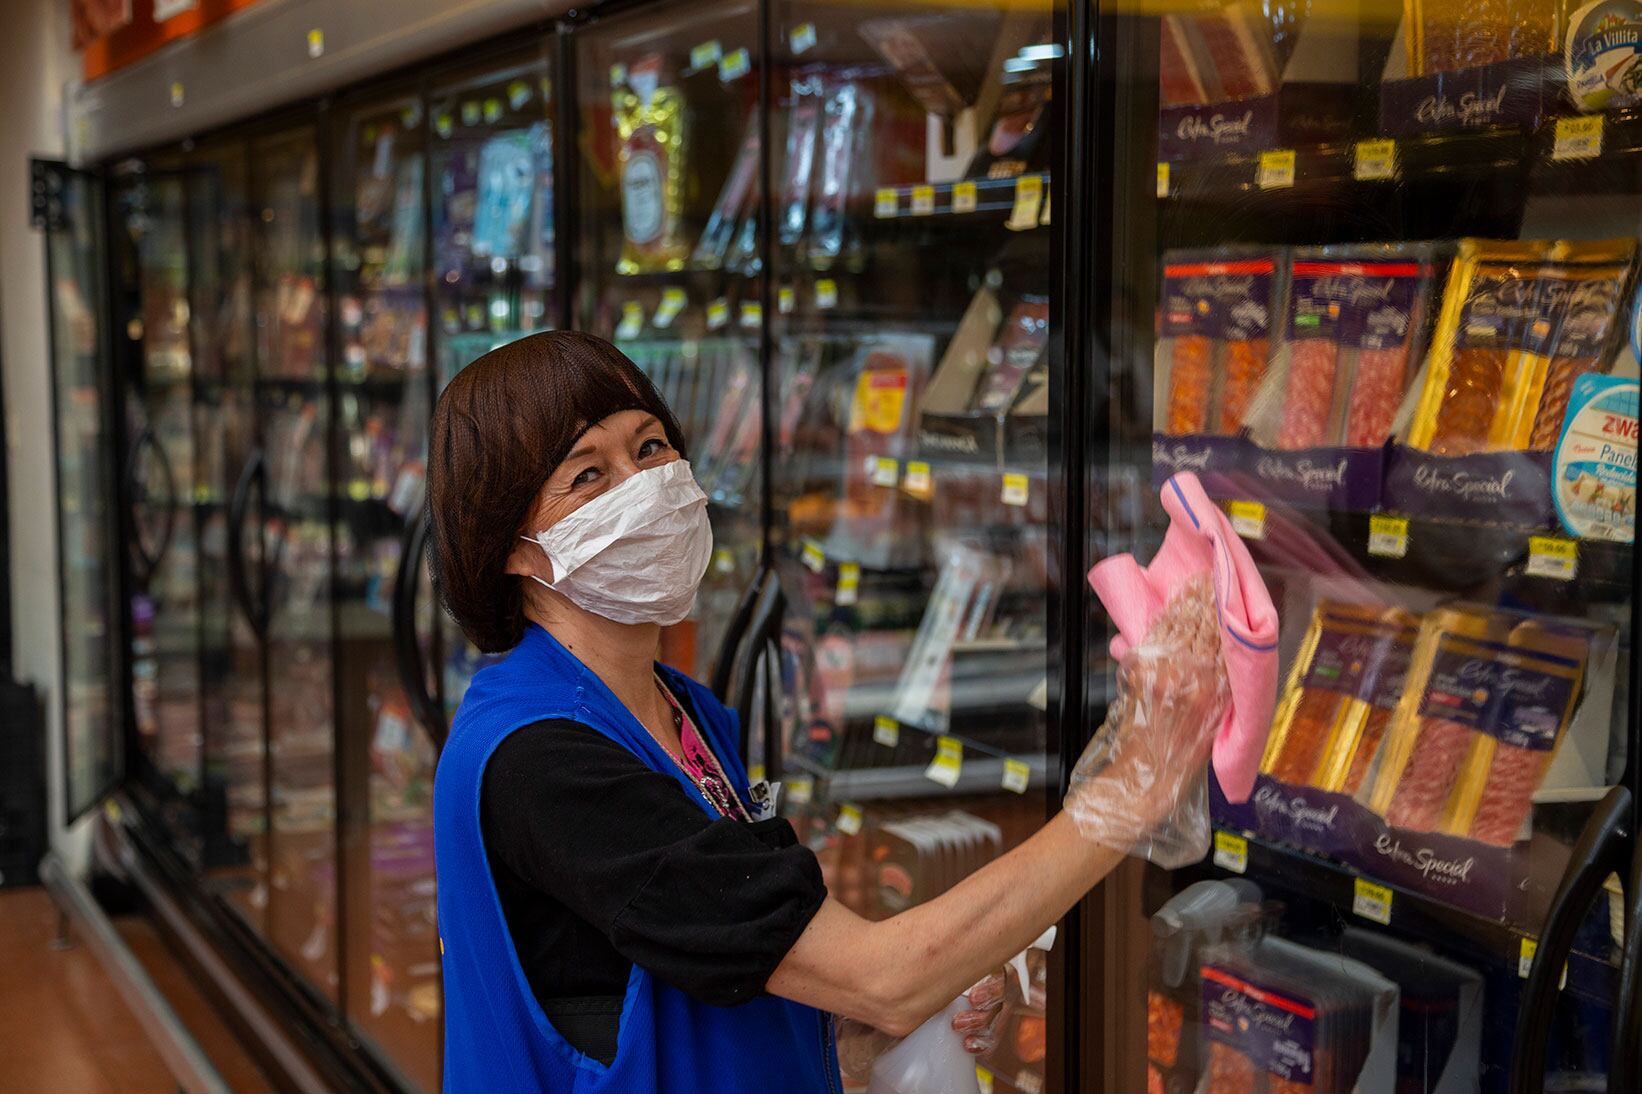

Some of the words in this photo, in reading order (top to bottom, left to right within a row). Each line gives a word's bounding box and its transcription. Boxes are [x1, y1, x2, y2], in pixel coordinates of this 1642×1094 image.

[1603, 30, 1639, 48] Villita
[1600, 443, 1638, 468] Panel
[1413, 464, 1451, 493] Extra
[1452, 469, 1515, 503] Special
[1374, 833, 1416, 863] Extra
[1414, 848, 1474, 882] Special
